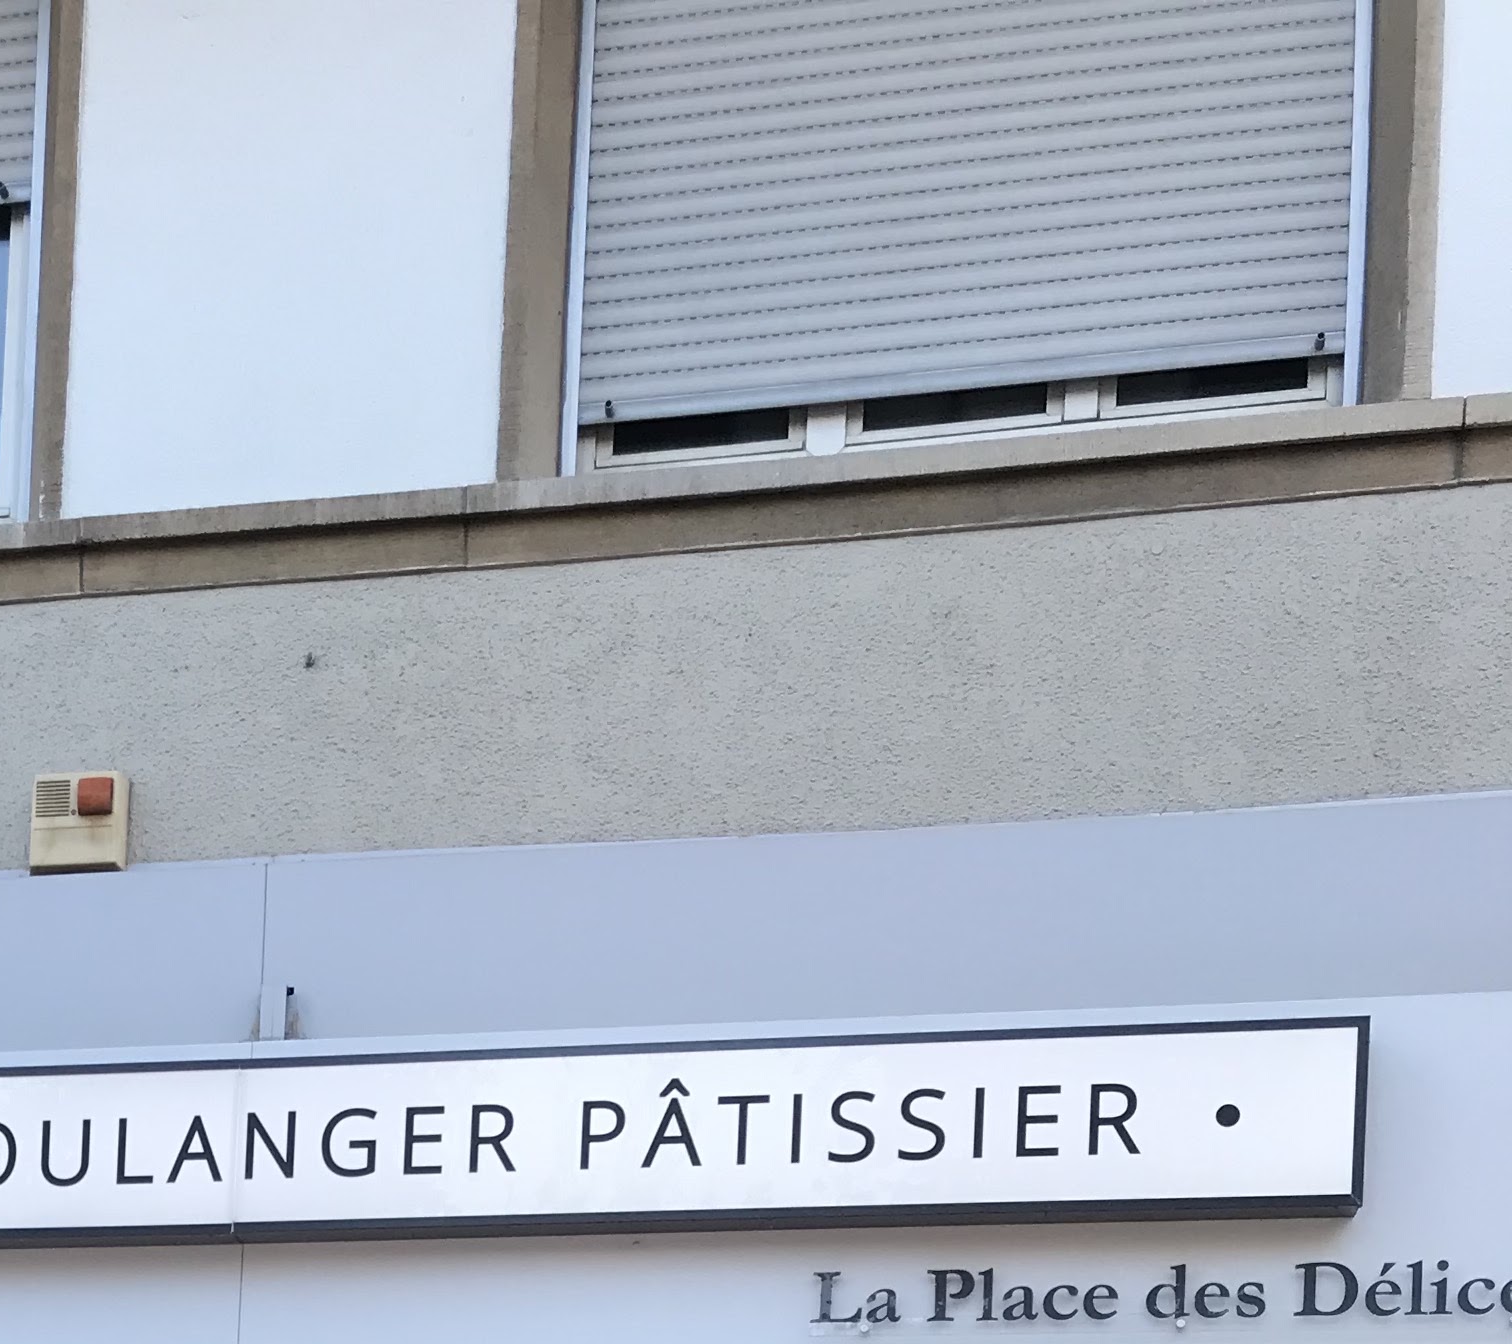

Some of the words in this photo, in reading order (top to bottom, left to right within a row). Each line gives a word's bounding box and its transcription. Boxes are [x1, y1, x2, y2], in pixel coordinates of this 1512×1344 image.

[578, 1077, 1141, 1171] PÂTISSIER
[812, 1270, 902, 1326] La
[929, 1266, 1121, 1324] Place
[1144, 1263, 1268, 1322] des
